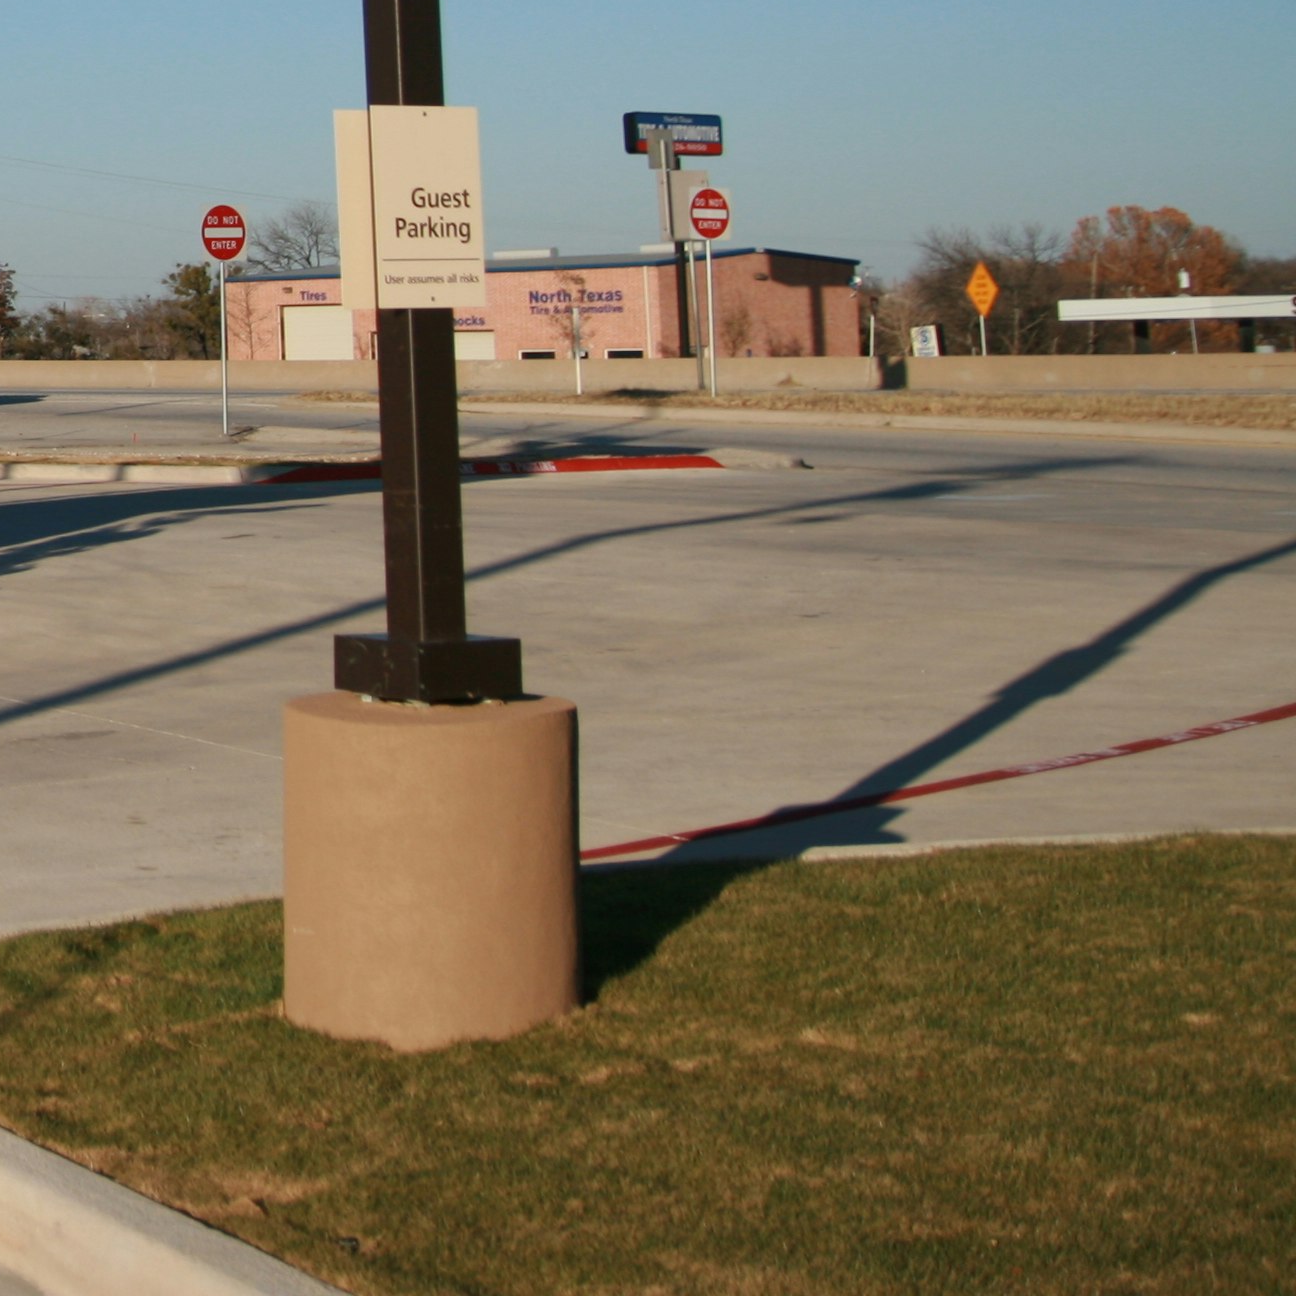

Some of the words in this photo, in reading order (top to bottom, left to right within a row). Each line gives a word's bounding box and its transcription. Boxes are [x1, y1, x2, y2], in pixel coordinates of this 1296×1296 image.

[411, 187, 470, 208] Guest
[695, 198, 705, 206] DO
[709, 199, 724, 207] NOT
[207, 216, 218, 224] DO
[223, 216, 238, 224] NOT
[698, 220, 722, 229] ENTER
[395, 216, 471, 244] Parking
[211, 241, 236, 249] ENTER
[385, 275, 405, 284] User
[408, 276, 444, 284] assumes
[447, 274, 458, 283] all
[460, 274, 480, 283] risks
[299, 290, 327, 301] Tires
[529, 290, 572, 303] North
[577, 290, 623, 302] Texas
[529, 306, 549, 315] Tire
